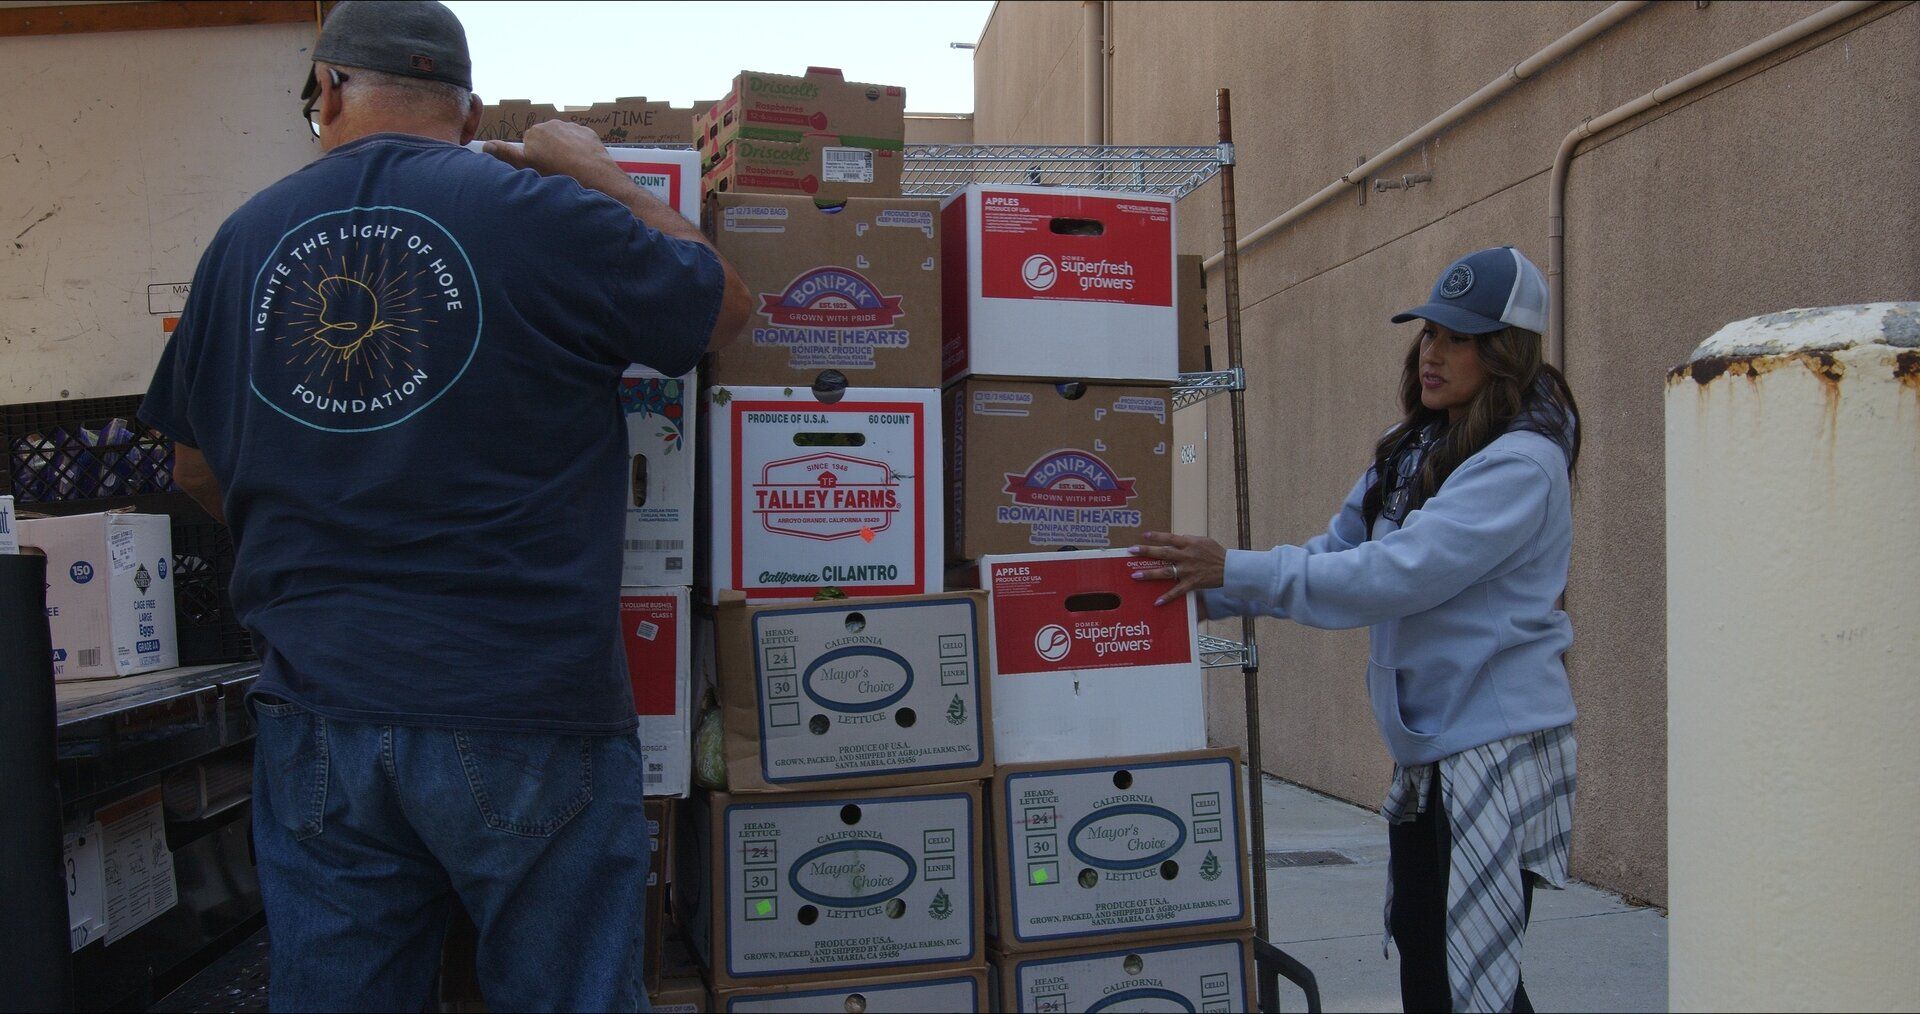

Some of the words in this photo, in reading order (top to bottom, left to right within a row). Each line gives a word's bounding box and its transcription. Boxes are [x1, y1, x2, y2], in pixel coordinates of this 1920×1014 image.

[749, 76, 819, 98] Driscoll's
[755, 101, 804, 114] Raspberries
[612, 110, 655, 127] TIME
[739, 142, 812, 162] Driscoll's
[744, 165, 795, 177] Raspberries
[634, 176, 665, 187] COUNT
[985, 197, 1020, 206] APPLES
[751, 208, 769, 216] HEAD
[770, 208, 787, 216] BAGS
[1061, 259, 1133, 277] superfresh
[255, 263, 291, 332] IGNITE
[290, 232, 329, 260] THE
[340, 225, 403, 240] LIGHT
[407, 236, 433, 255] OF
[429, 258, 462, 311] HOPE
[1080, 276, 1134, 291] growers
[791, 274, 872, 305] BONIPAK
[789, 313, 824, 322] GROWN
[851, 313, 877, 321] PRIDE
[754, 329, 836, 344] ROMAINE
[843, 331, 908, 345] HEARTS
[791, 346, 830, 354] BONIPAK
[832, 347, 872, 355] PRODUCE
[291, 369, 429, 413] FOUNDATION
[748, 414, 789, 424] PRODUCE
[791, 414, 802, 424] OF
[803, 414, 829, 424] U.S.A.
[868, 415, 878, 424] 60
[880, 415, 910, 425] COUNT
[806, 463, 829, 472] SINCE
[1033, 458, 1107, 488] BONIPAK
[821, 477, 834, 486] TF
[756, 489, 828, 509] TALLEY
[833, 489, 896, 509] FARMS
[1031, 493, 1063, 502] GROWN
[999, 508, 1075, 522] ROMAINE
[1081, 510, 1140, 525] HEARTS
[1032, 524, 1067, 532] BONIPAK
[1069, 525, 1107, 533] PRODUCE
[72, 564, 90, 577] 150
[759, 570, 820, 584] California
[822, 564, 898, 581] CILANTRO
[996, 567, 1030, 576] APPLES
[134, 600, 147, 610] CAGE
[147, 600, 156, 609] FREE
[139, 612, 152, 623] LARGE
[139, 625, 154, 637] Eggs
[765, 628, 793, 636] HEADS
[1075, 621, 1150, 642] superfresh
[761, 635, 799, 645] LETTUCE
[824, 636, 882, 650] CALIFORNIA
[943, 641, 963, 649] CELLO
[1096, 639, 1150, 657] growers
[773, 652, 789, 664] 24
[820, 666, 869, 684] Mayor's
[943, 669, 966, 677] LINER
[775, 681, 790, 694] 30
[858, 680, 895, 694] Choice
[838, 712, 886, 725] LETTUCE
[839, 743, 877, 753] PRODUCE
[878, 743, 889, 751] OF
[891, 741, 910, 750] U.S.A.
[837, 753, 854, 761] AND
[855, 751, 885, 760] SHIPPED
[835, 761, 859, 769] SANTA
[1023, 788, 1054, 797] HEADS
[1019, 796, 1059, 805] LETTUCE
[1092, 795, 1154, 809] CALIFORNIA
[1195, 799, 1217, 807] CELLO
[744, 822, 776, 830] HEADS
[1087, 824, 1138, 840] Mayor's
[1196, 826, 1218, 835] LINER
[738, 829, 781, 837] LETTUCE
[817, 830, 883, 844] CALIFORNIA
[928, 836, 950, 844] CELLO
[1127, 838, 1167, 851] Choice
[1033, 841, 1050, 852] 30
[809, 861, 865, 878] Mayor's
[927, 864, 952, 872] LINER
[1105, 868, 1157, 881] LETTUCE
[752, 876, 769, 887] 30
[852, 876, 894, 888] Choice
[1094, 910, 1111, 918] AND
[1112, 907, 1143, 917] SHIPPED
[1144, 906, 1155, 914] BY
[1218, 899, 1232, 907] INC.
[1095, 900, 1135, 911] PRODUCE
[1137, 899, 1148, 907] OF
[826, 907, 883, 919] LETTUCE
[1091, 917, 1117, 926] SANTA
[813, 948, 831, 956] AND
[832, 946, 867, 955] SHIPPED
[947, 937, 962, 945] INC.
[815, 938, 857, 948] PRODUCE
[859, 938, 871, 946] OF
[872, 936, 893, 944] U.S.A.
[809, 956, 836, 964] SANTA
[1034, 976, 1065, 985] HEADS
[1102, 978, 1163, 994] CALIFORNIA
[1204, 981, 1224, 989] CELLO
[1030, 983, 1069, 993] LETTUCE
